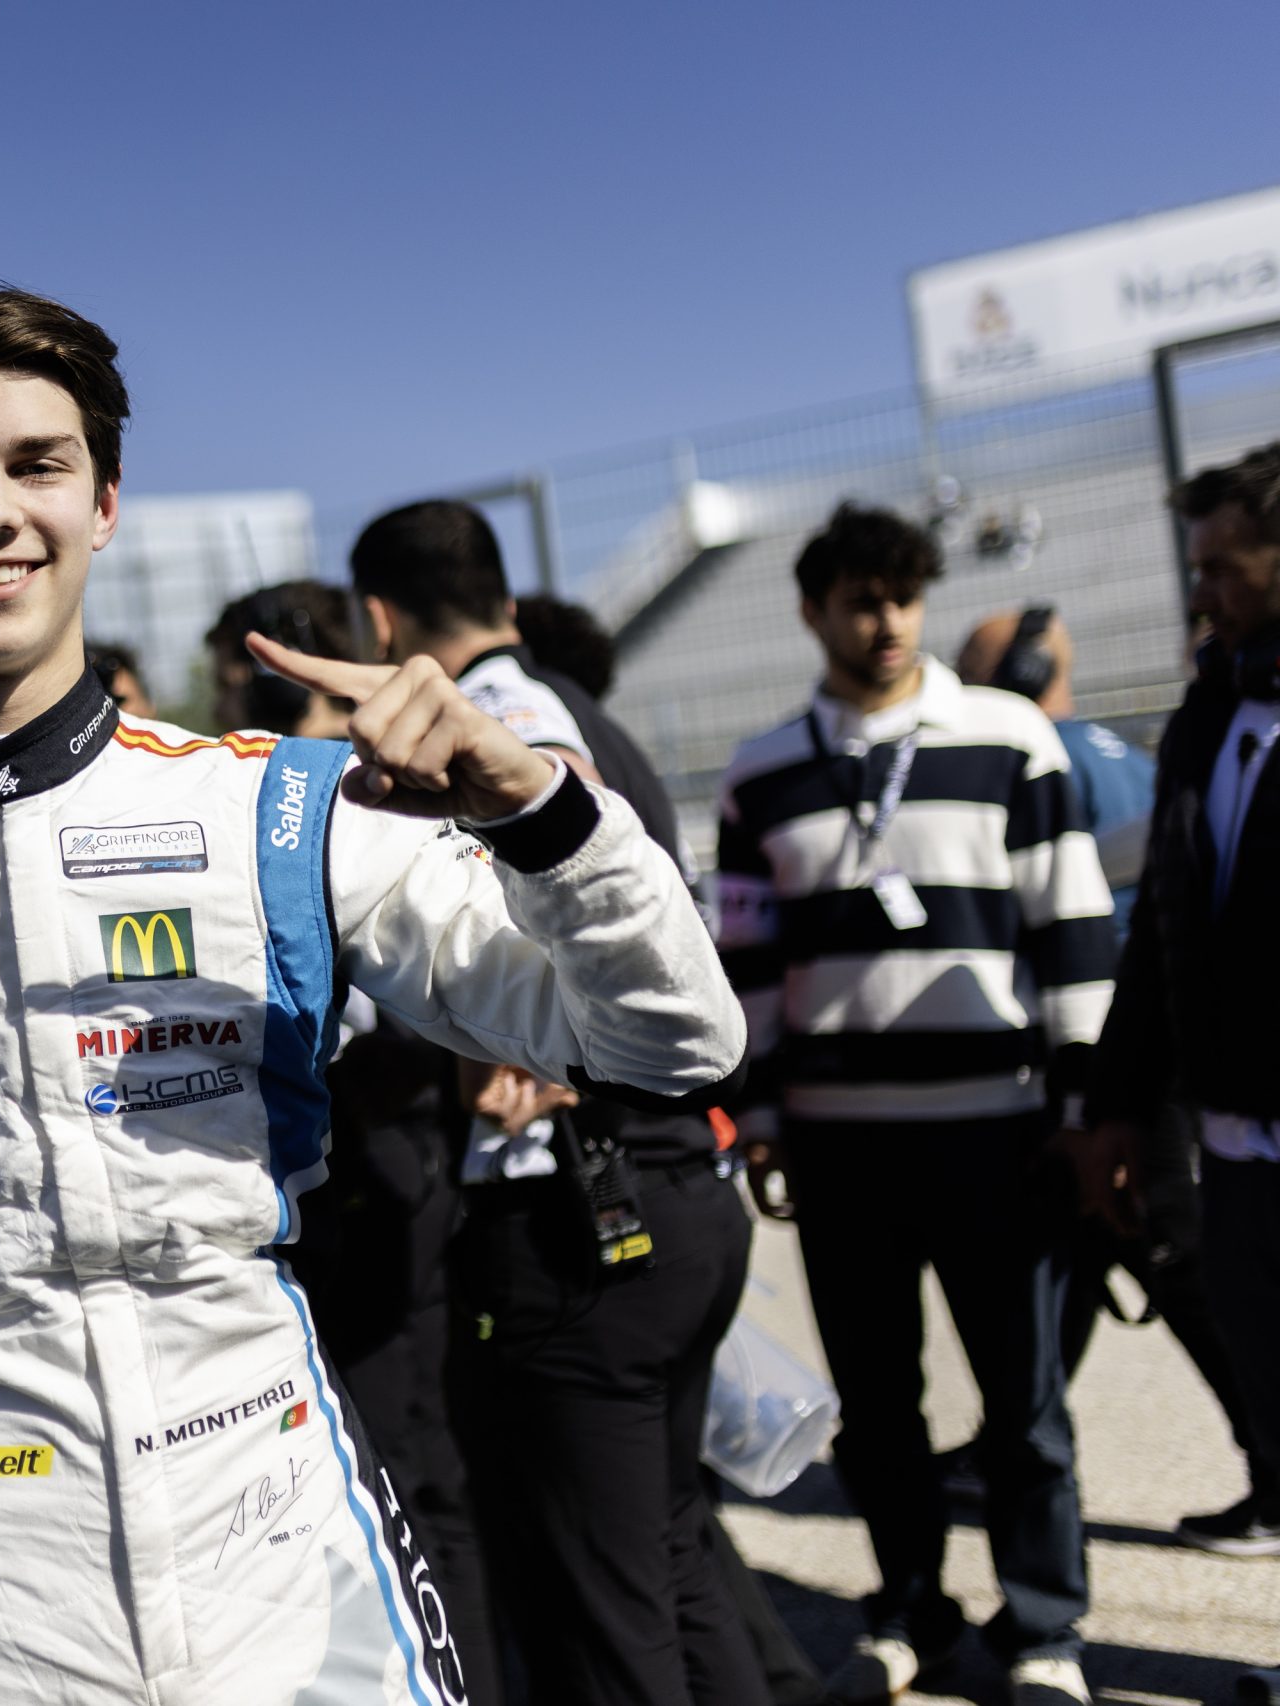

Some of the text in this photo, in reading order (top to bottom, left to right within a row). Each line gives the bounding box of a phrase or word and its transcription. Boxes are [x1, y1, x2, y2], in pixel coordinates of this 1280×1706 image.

[271, 766, 308, 851] Sabelt
[76, 1019, 242, 1059] MINERVA
[122, 1064, 239, 1103] KCMG
[145, 1090, 225, 1110] MOTORGROUP
[134, 1379, 295, 1456] N. MONTEIRO
